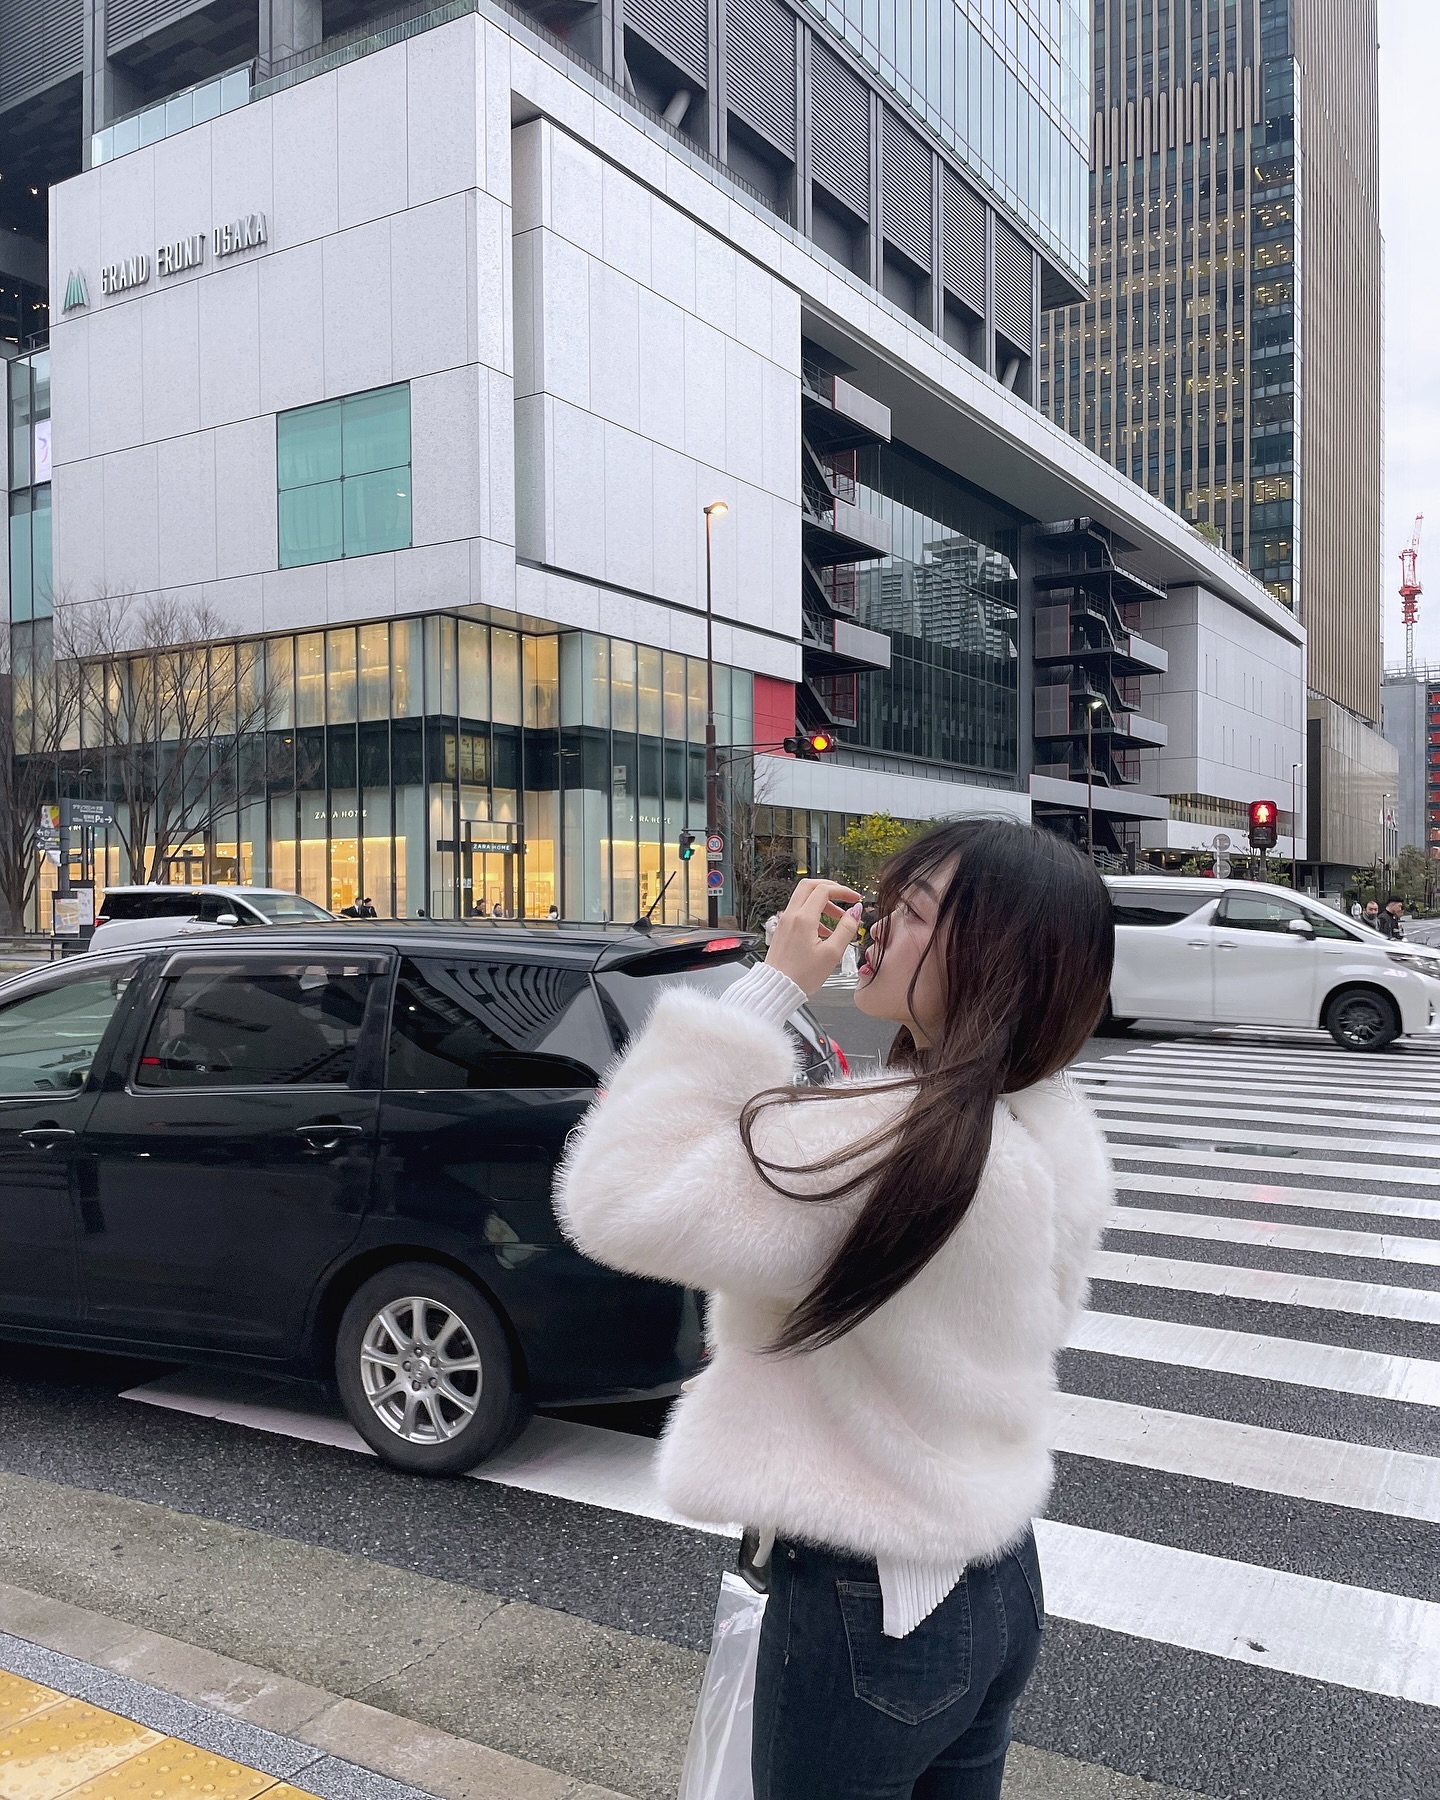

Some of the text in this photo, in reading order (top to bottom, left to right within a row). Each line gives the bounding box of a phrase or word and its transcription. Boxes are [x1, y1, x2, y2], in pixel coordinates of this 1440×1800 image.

[101, 210, 268, 295] GRAND FRONT OSAKA
[314, 811, 339, 820] ZAA
[710, 840, 720, 848] 30
